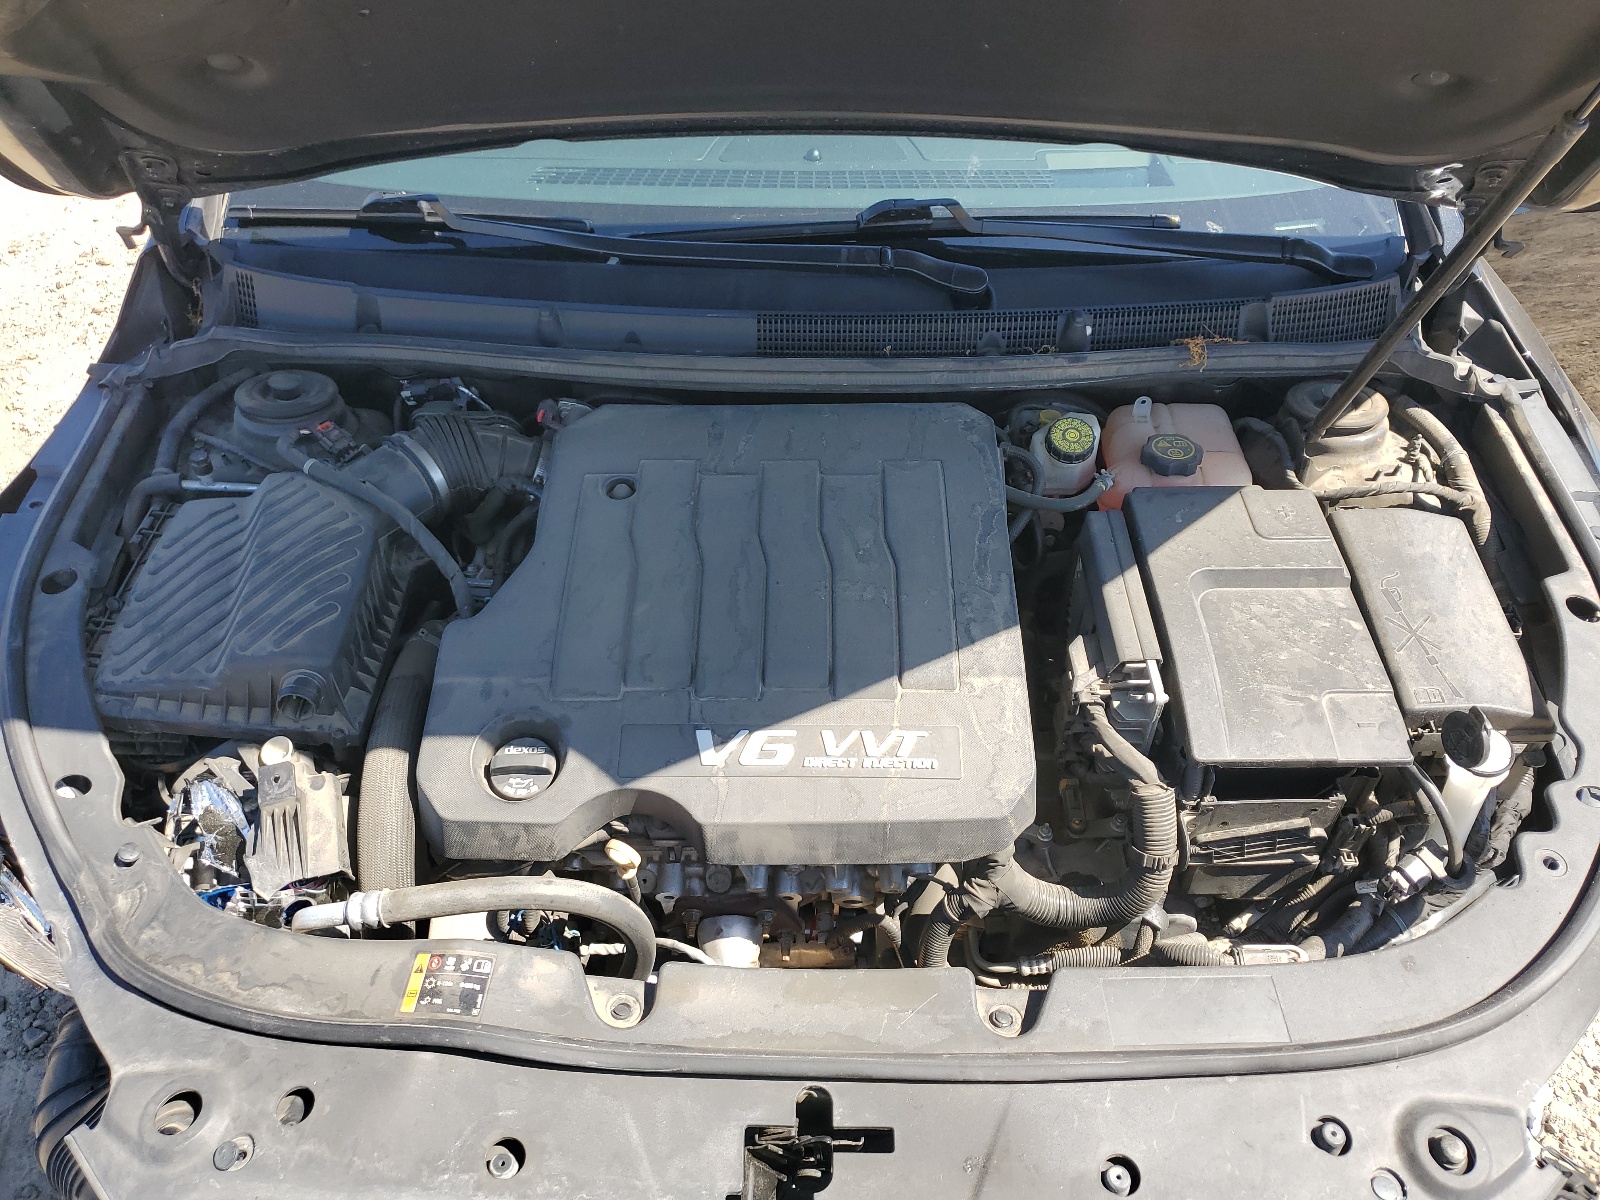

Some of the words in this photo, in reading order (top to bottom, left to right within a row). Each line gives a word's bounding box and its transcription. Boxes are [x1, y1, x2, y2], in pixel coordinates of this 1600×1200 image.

[504, 745, 547, 755] dexos
[695, 729, 798, 767] V6
[820, 729, 930, 757] VVT
[802, 756, 858, 769] DIRECT
[861, 757, 939, 770] INJECTION
